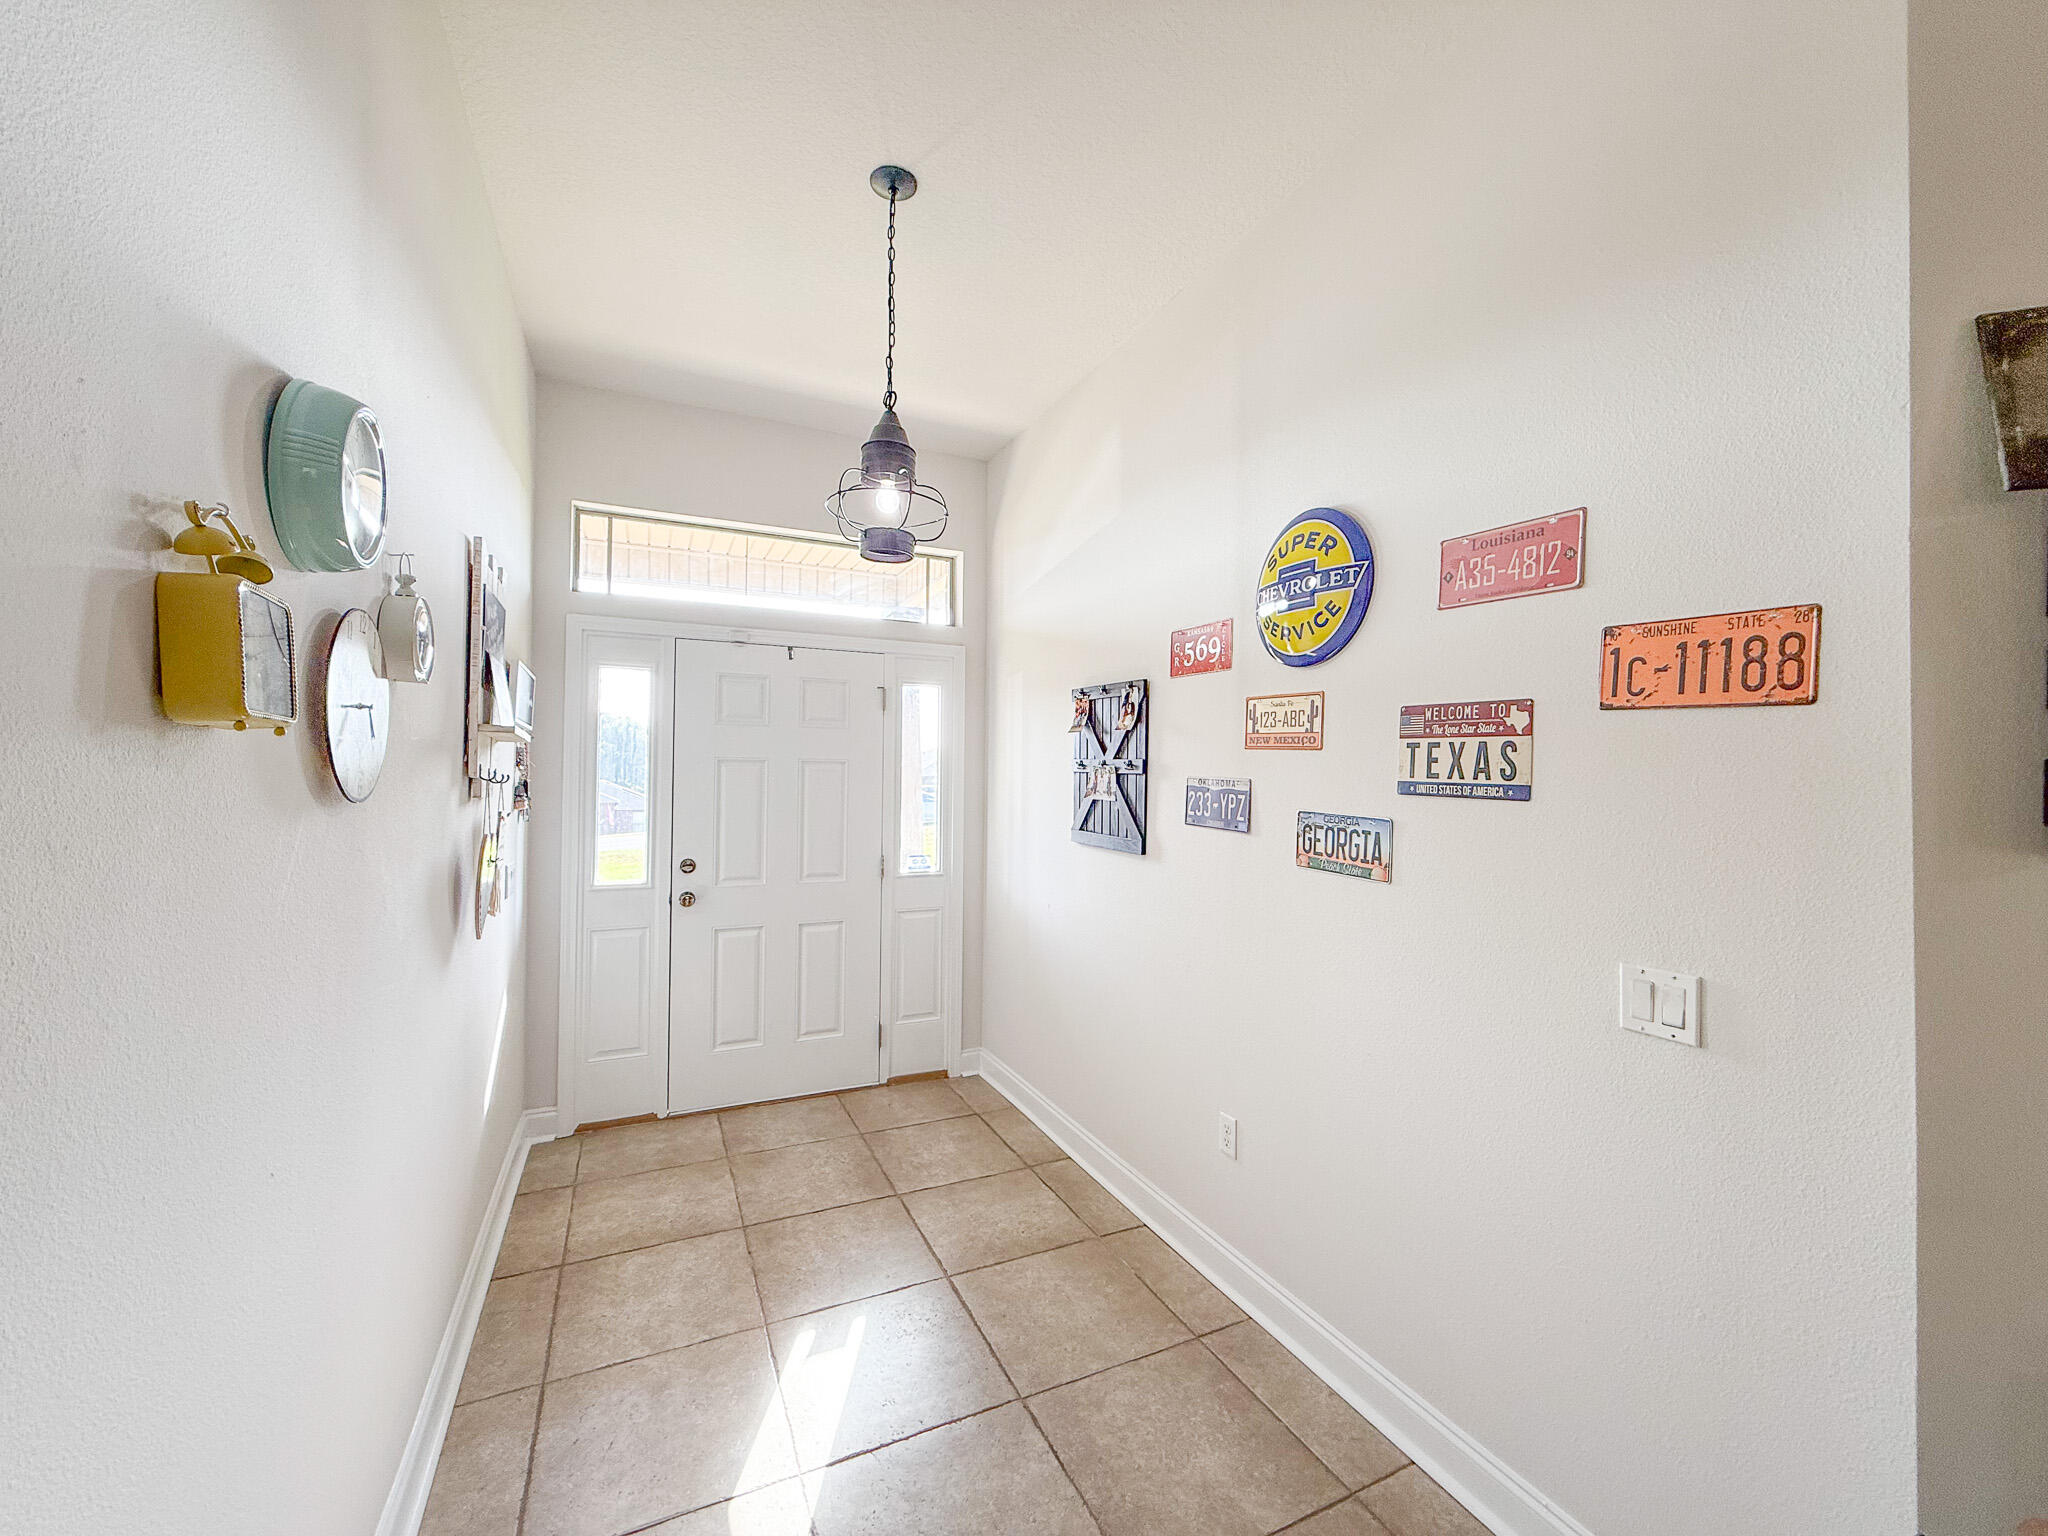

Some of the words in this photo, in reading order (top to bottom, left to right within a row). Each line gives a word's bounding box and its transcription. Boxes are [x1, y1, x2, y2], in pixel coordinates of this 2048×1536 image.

[1472, 526, 1545, 551] Louisiana
[1268, 531, 1338, 572] SUPER
[1455, 540, 1562, 592] A35-4812
[1258, 567, 1361, 605] CHEVROLET
[1263, 600, 1342, 642] SERVICE
[1641, 621, 1698, 638] SUNSHINE
[1727, 614, 1766, 631] STATE
[1794, 609, 1810, 624] 28
[1183, 635, 1221, 667] 569
[1260, 709, 1305, 728] 123-ABC
[1425, 704, 1480, 720] WELCOME
[1490, 703, 1506, 718] TO
[1249, 736, 1271, 745] NEW
[1273, 735, 1317, 745] MEXICO
[1432, 725, 1443, 735] The
[1444, 724, 1459, 736] Lone
[1460, 723, 1476, 734] Star
[1477, 722, 1497, 733] State
[1406, 740, 1518, 781] TEXAS
[1198, 778, 1236, 787] OKLAHOMA
[1416, 784, 1438, 794] UNITED
[1438, 785, 1462, 795] STATES
[1463, 786, 1471, 796] OF
[1472, 786, 1504, 797] AMERICA
[1323, 815, 1361, 826] GEORGIA
[1302, 824, 1382, 866] GEORGIA
